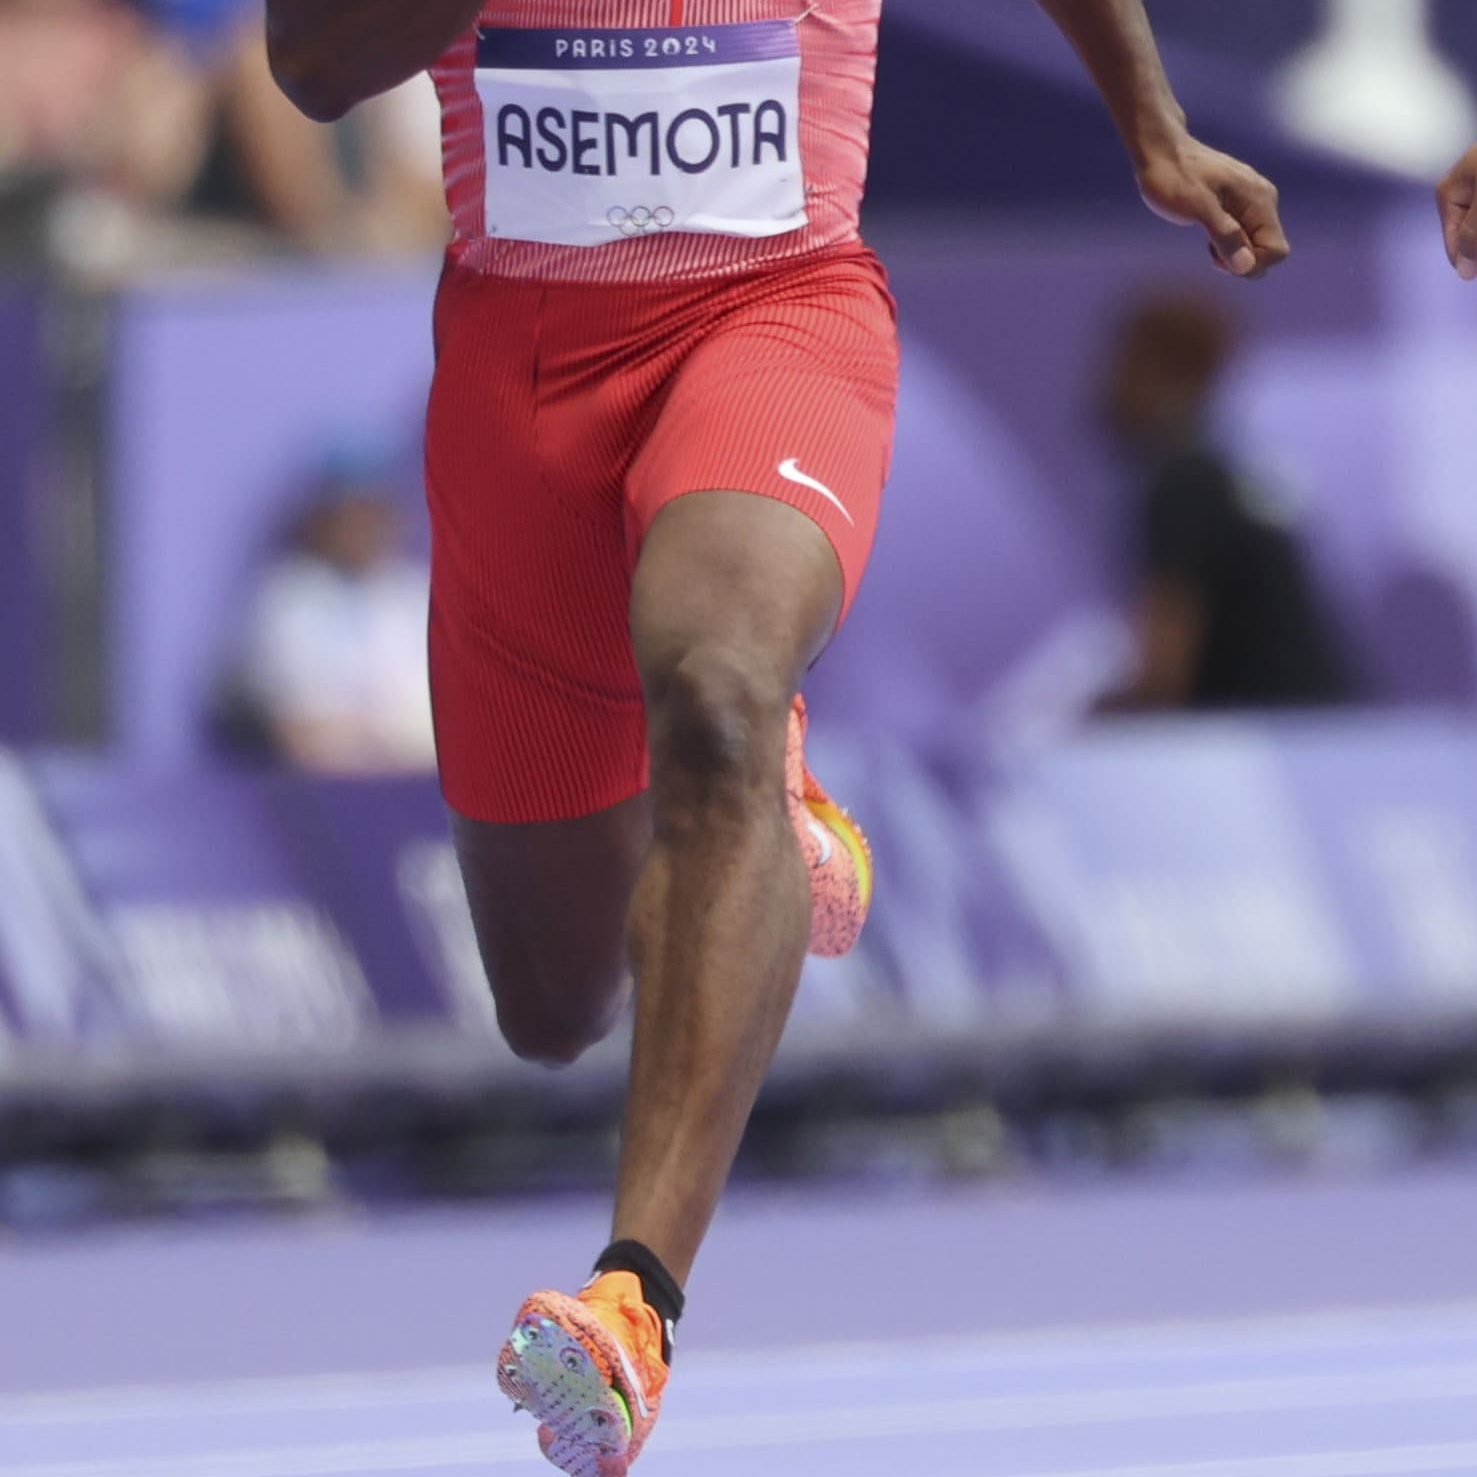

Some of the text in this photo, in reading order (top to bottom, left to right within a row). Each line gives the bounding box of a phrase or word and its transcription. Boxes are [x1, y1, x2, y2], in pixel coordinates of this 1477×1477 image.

[555, 35, 717, 58] PARIS 2024
[496, 99, 787, 176] ASEMOTA
